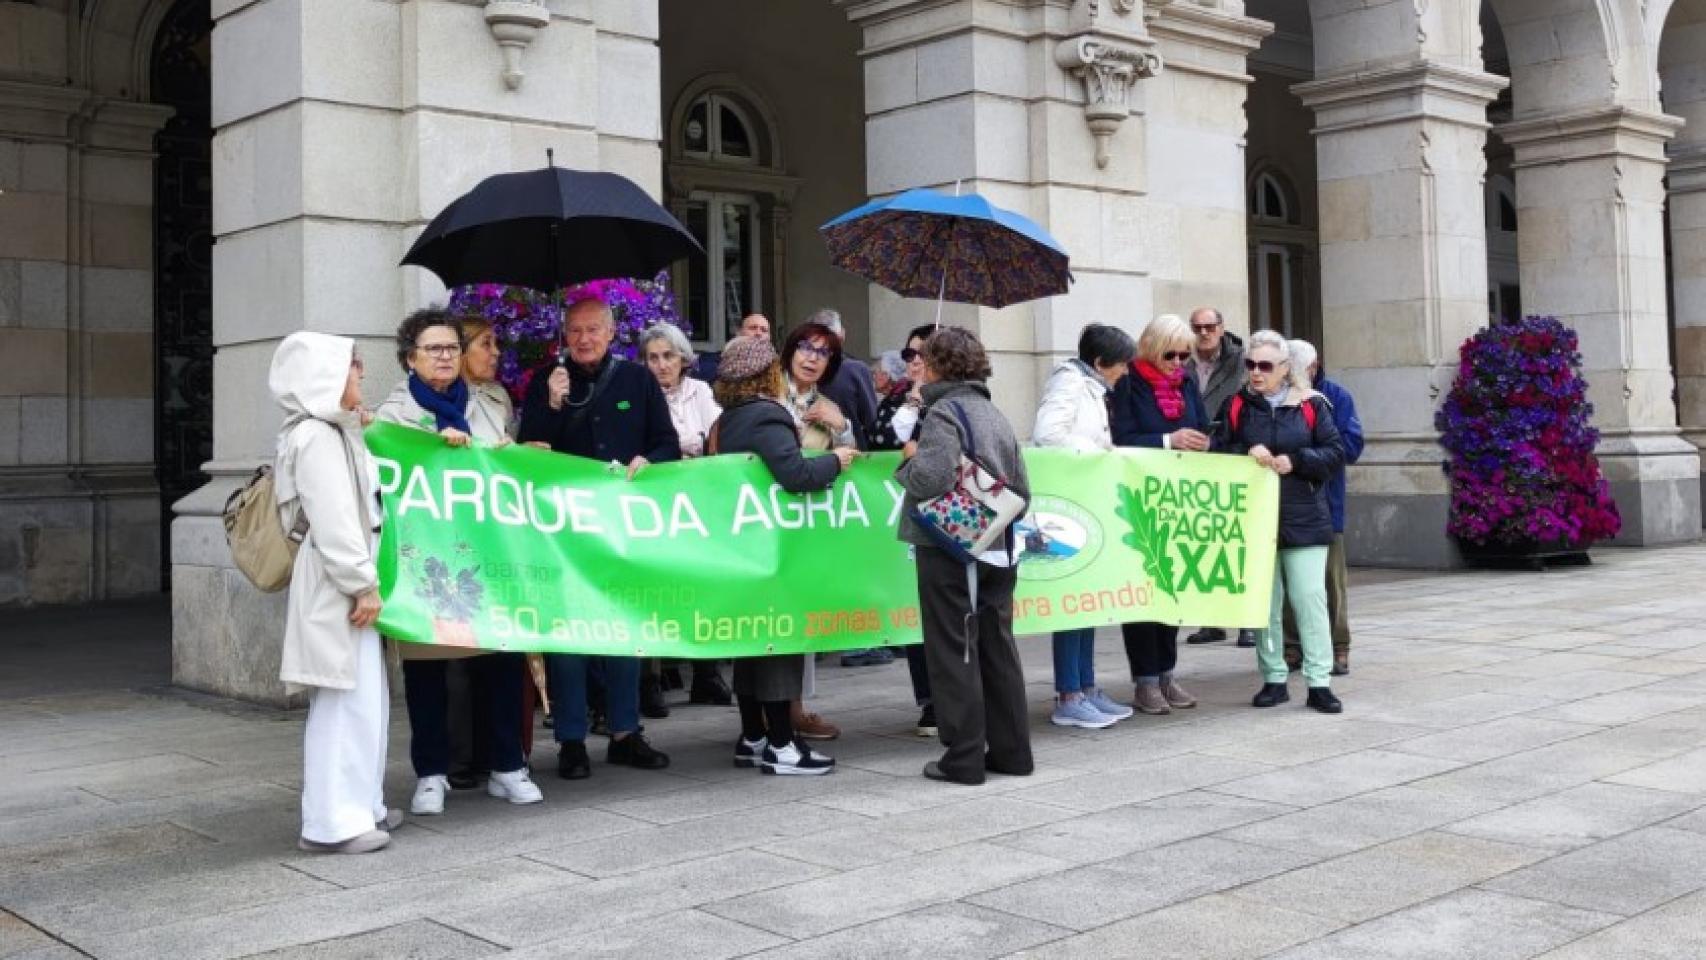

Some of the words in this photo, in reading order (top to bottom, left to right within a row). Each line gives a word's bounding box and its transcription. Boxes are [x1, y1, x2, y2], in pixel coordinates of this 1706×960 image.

[375, 458, 605, 533] PARQUE
[619, 491, 709, 538] DA
[731, 479, 870, 535] AGRA
[1144, 475, 1248, 512] PARQUE
[1159, 507, 1178, 521] DA
[1171, 511, 1245, 543] AGRA
[1176, 542, 1246, 593] XA!
[489, 605, 540, 639] 50
[552, 617, 631, 642] anos
[641, 611, 681, 641] de
[694, 606, 793, 641] barrio
[804, 608, 881, 638] zonas
